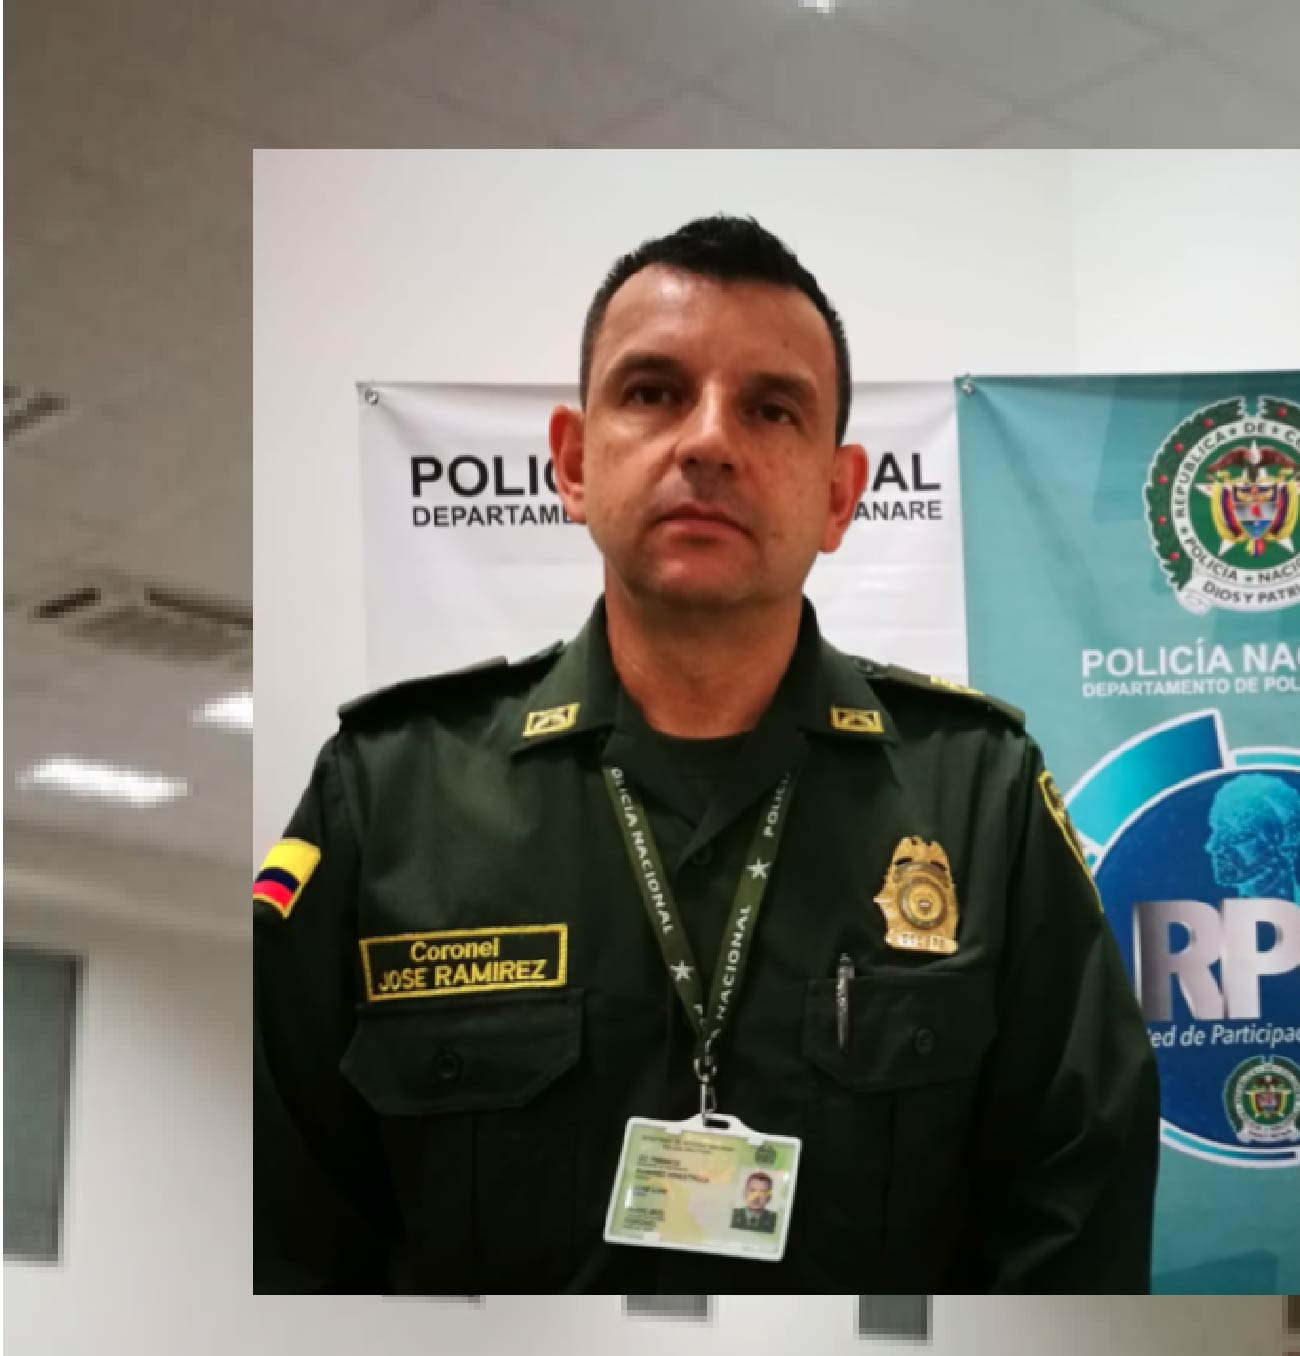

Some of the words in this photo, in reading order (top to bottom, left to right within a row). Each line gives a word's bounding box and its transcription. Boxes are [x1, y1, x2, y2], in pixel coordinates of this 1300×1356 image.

[871, 451, 942, 492] AL
[1174, 431, 1226, 519] REPUBLICA
[1243, 422, 1267, 434] DE
[854, 499, 943, 521] ANARE
[1184, 537, 1239, 582] POLICIA
[1202, 581, 1240, 601] DIOS
[1243, 592, 1254, 604] Y
[1081, 637, 1234, 678] POLICÍA
[1082, 677, 1231, 697] DEPARTAMENTO
[1235, 676, 1259, 694] DE
[631, 830, 674, 936] NACIONAL
[410, 936, 500, 963] Coronel
[715, 904, 751, 1020] NACIONAL
[378, 967, 428, 993] JOSE
[434, 959, 548, 987] RAMIREZ
[1147, 1024, 1177, 1048] ed
[1179, 1024, 1205, 1047] de
